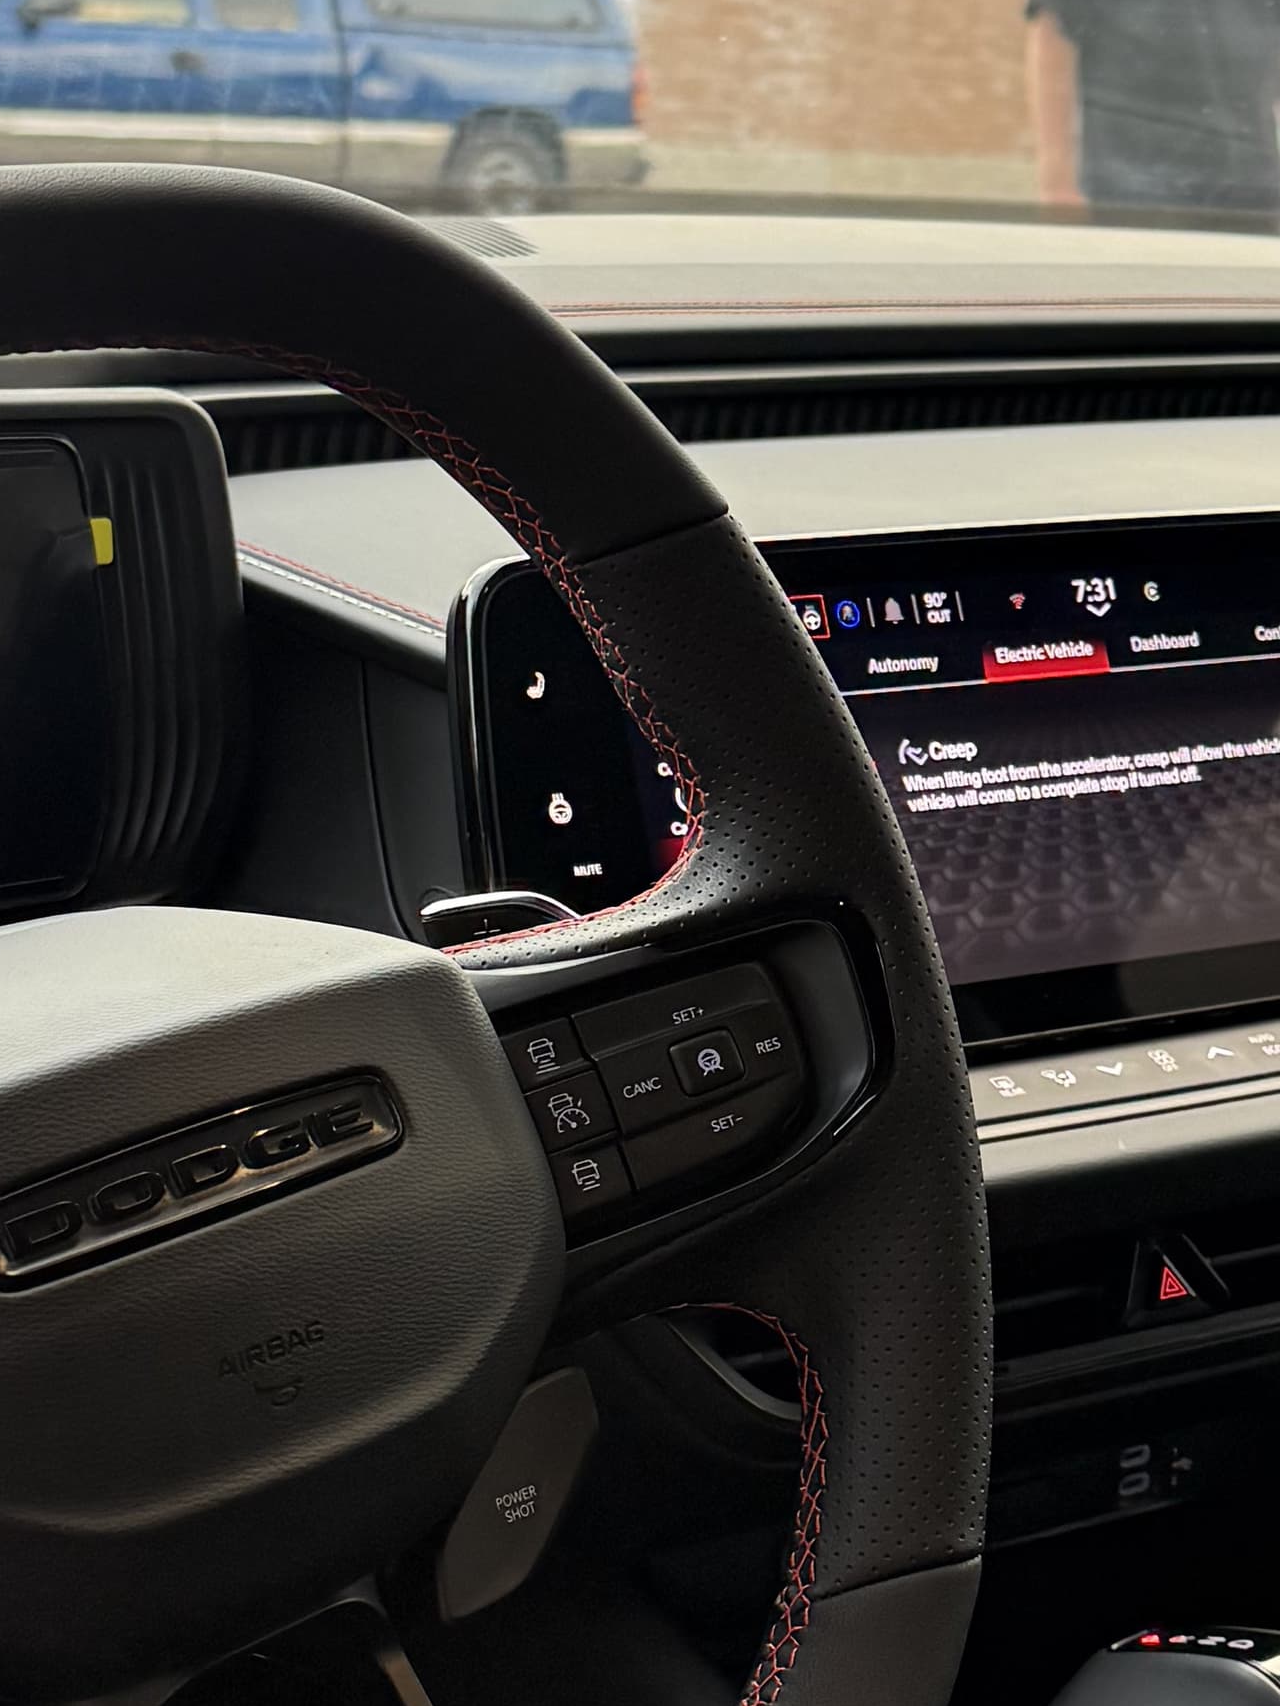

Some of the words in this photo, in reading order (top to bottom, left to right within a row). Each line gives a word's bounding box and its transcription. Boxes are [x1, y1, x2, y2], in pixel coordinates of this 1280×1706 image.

[923, 592, 947, 608] 90°
[1071, 578, 1117, 604] 7:31
[927, 609, 952, 624] OUT
[1130, 631, 1200, 652] Dashboard
[994, 645, 1045, 665] Electric
[1046, 641, 1095, 660] Vehicle
[868, 655, 939, 675] Autonomy
[928, 740, 978, 762] Creep
[902, 773, 944, 793] When
[945, 768, 983, 791] lifting
[982, 765, 1010, 785] foot
[1009, 761, 1041, 781] from
[1040, 760, 1062, 779] the
[1134, 751, 1170, 770] creep
[1169, 746, 1191, 765] will
[1191, 743, 1224, 762] allow
[1223, 741, 1245, 759] the
[907, 792, 956, 813] vehicle
[955, 787, 979, 808] will
[978, 787, 1016, 806] come
[1015, 783, 1031, 802] to
[1040, 776, 1101, 799] complete
[1099, 773, 1128, 794] stop
[1127, 770, 1139, 789] if
[1138, 768, 1181, 789] turned
[573, 863, 603, 877] MUTE
[672, 1006, 704, 1025] SET+
[755, 1037, 781, 1054] RES
[623, 1076, 662, 1099] CANC
[2, 1101, 373, 1258] DODGE
[219, 1320, 325, 1378] AIRBAG
[495, 1485, 537, 1511] POWER
[505, 1501, 536, 1523] SHOT
